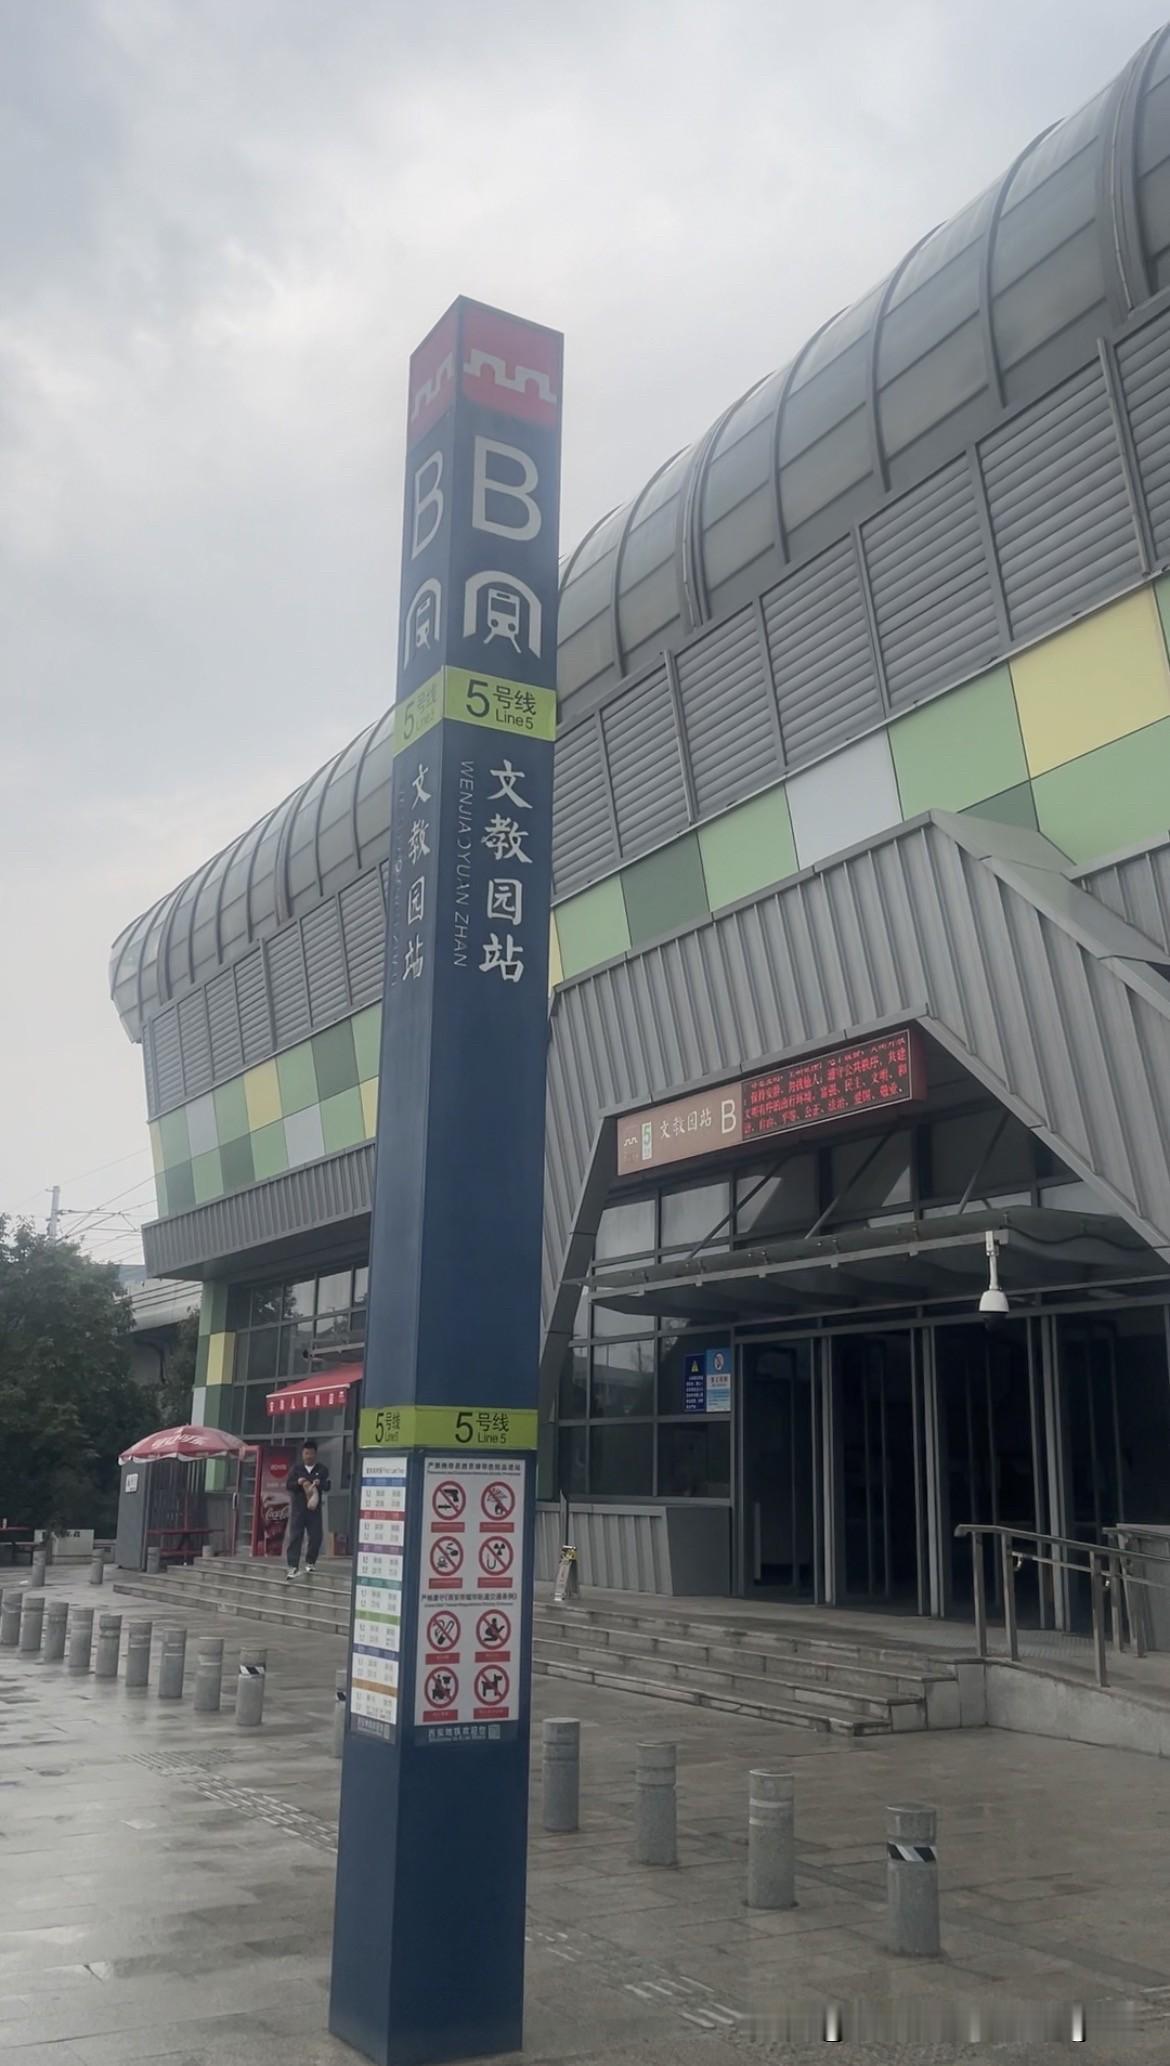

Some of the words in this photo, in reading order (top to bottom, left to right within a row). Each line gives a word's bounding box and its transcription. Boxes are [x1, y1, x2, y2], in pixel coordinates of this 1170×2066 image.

[411, 451, 444, 560] B
[471, 435, 543, 541] B
[465, 679, 537, 718] 5号线
[495, 709, 523, 727] Line
[402, 762, 432, 982] 文教园站
[479, 758, 533, 984] 文教园站
[453, 911, 470, 968] ZHAN
[660, 1107, 712, 1138] 文教园站
[721, 1099, 737, 1134] B
[455, 1411, 510, 1444] 5号线
[477, 1433, 498, 1444] Line
